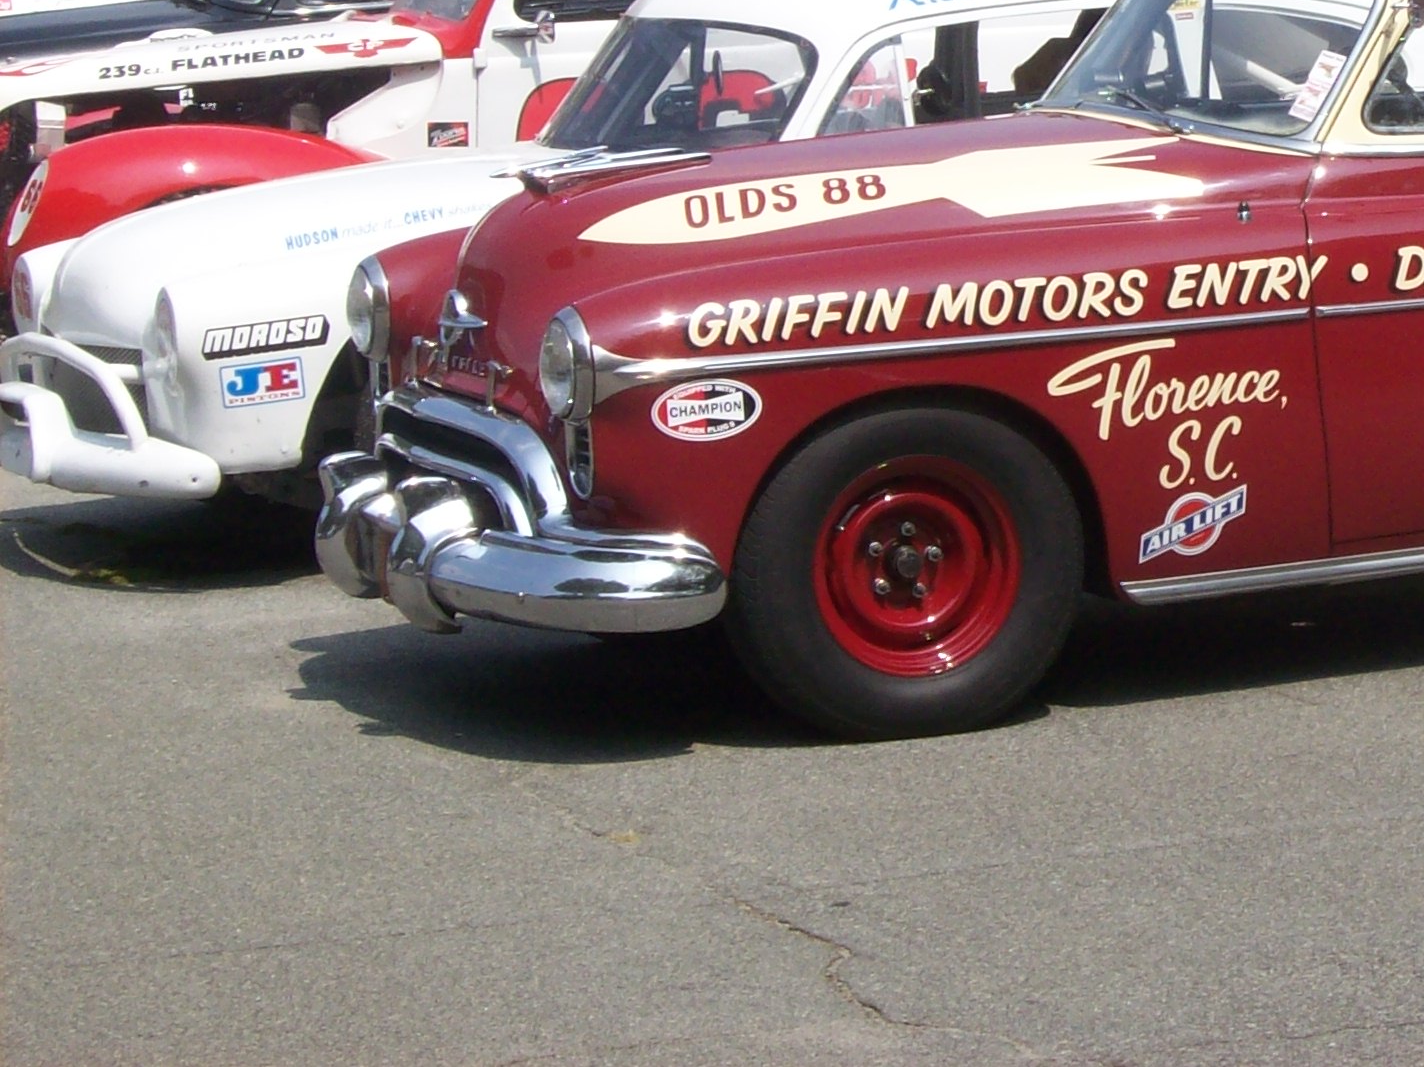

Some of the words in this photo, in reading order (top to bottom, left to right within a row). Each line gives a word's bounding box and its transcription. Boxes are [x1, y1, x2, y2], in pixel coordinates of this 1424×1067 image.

[178, 32, 336, 52] SPORTSMAN
[98, 63, 141, 80] 239
[171, 47, 305, 71] FLATHEAD
[685, 182, 798, 229] OLDS
[822, 174, 887, 205] 88
[285, 227, 339, 250] HUDSON
[404, 206, 444, 225] CHEVY
[688, 286, 909, 349] GRIFFIN
[926, 269, 1148, 330] MOTORS
[1166, 254, 1329, 310] ENTRY
[203, 316, 326, 355] MOROSO
[226, 362, 299, 397] JE
[228, 391, 301, 405] PISTONS
[1047, 338, 1288, 440] Florence,
[669, 400, 742, 418] CHAMPION
[1159, 415, 1243, 489] S.C.
[1146, 522, 1187, 554] AIR
[1192, 494, 1241, 532] LIFT
